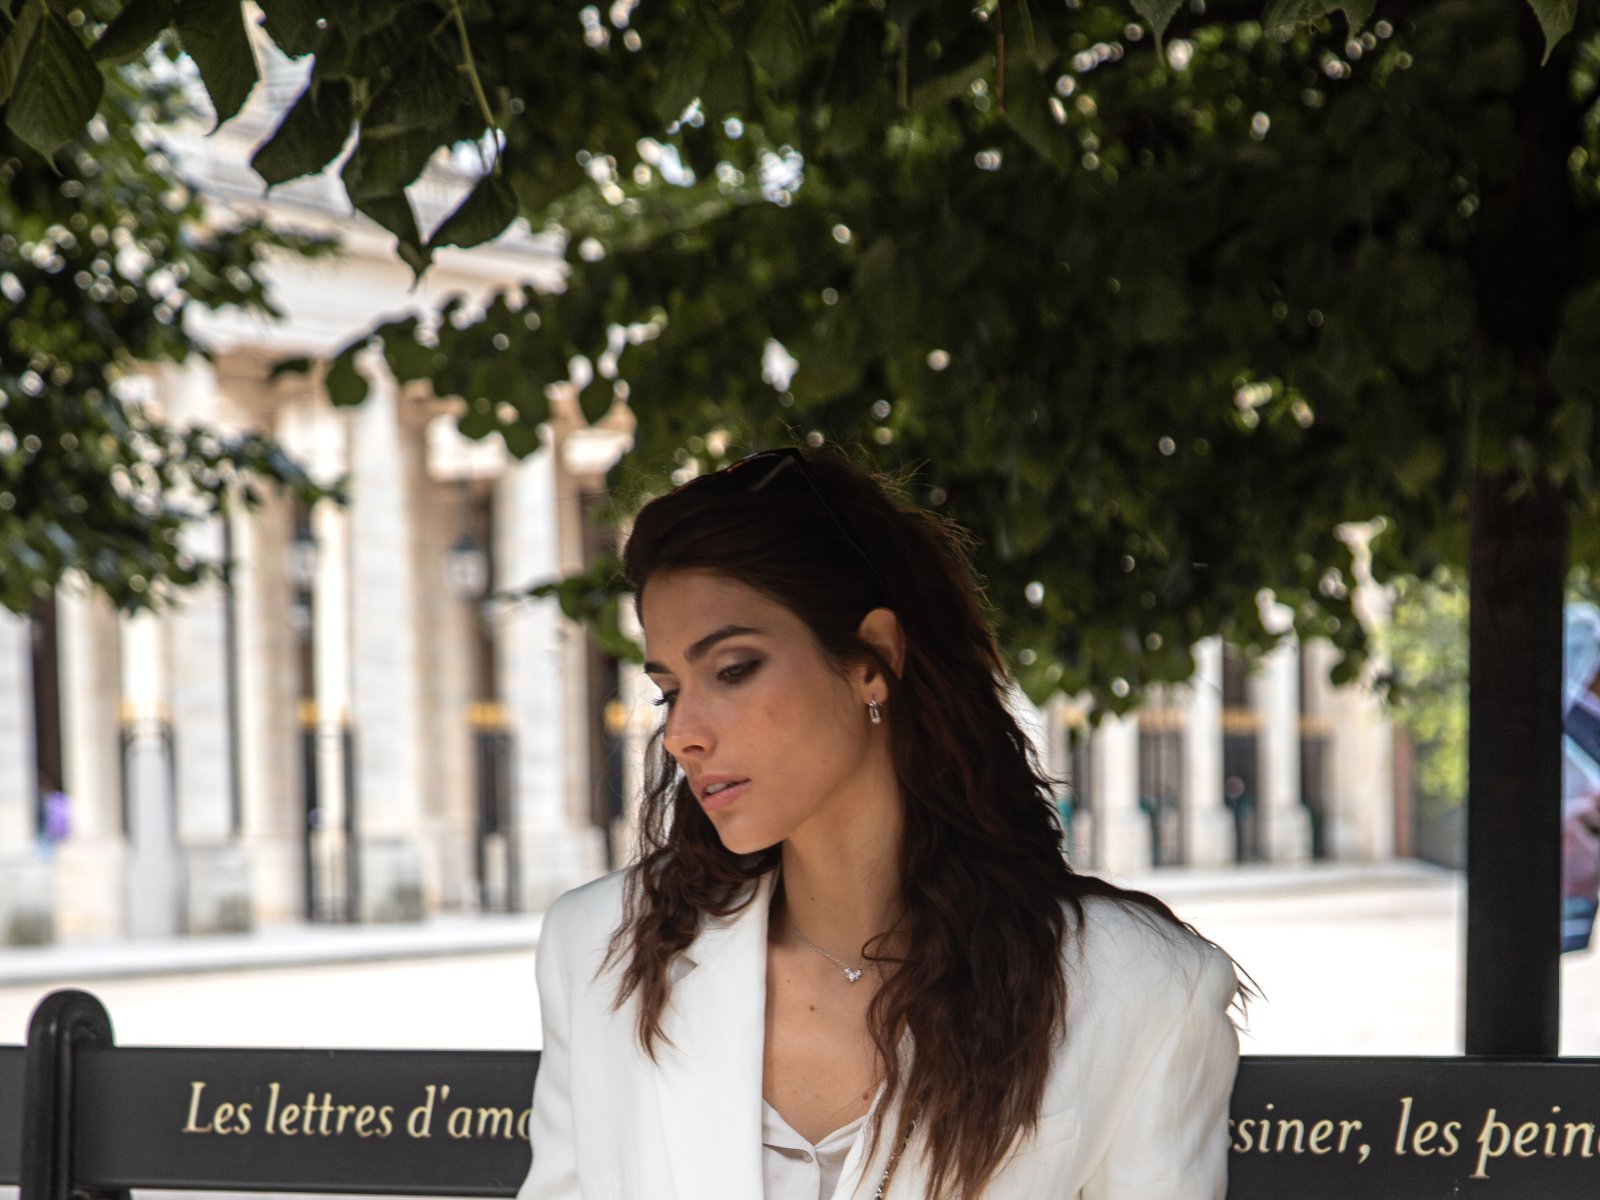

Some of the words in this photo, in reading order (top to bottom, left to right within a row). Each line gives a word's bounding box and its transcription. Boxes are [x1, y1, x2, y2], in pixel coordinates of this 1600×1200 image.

[183, 1081, 252, 1135] Les
[265, 1082, 394, 1137] lettres
[1395, 1097, 1461, 1156] les
[1470, 1106, 1600, 1178] pein
